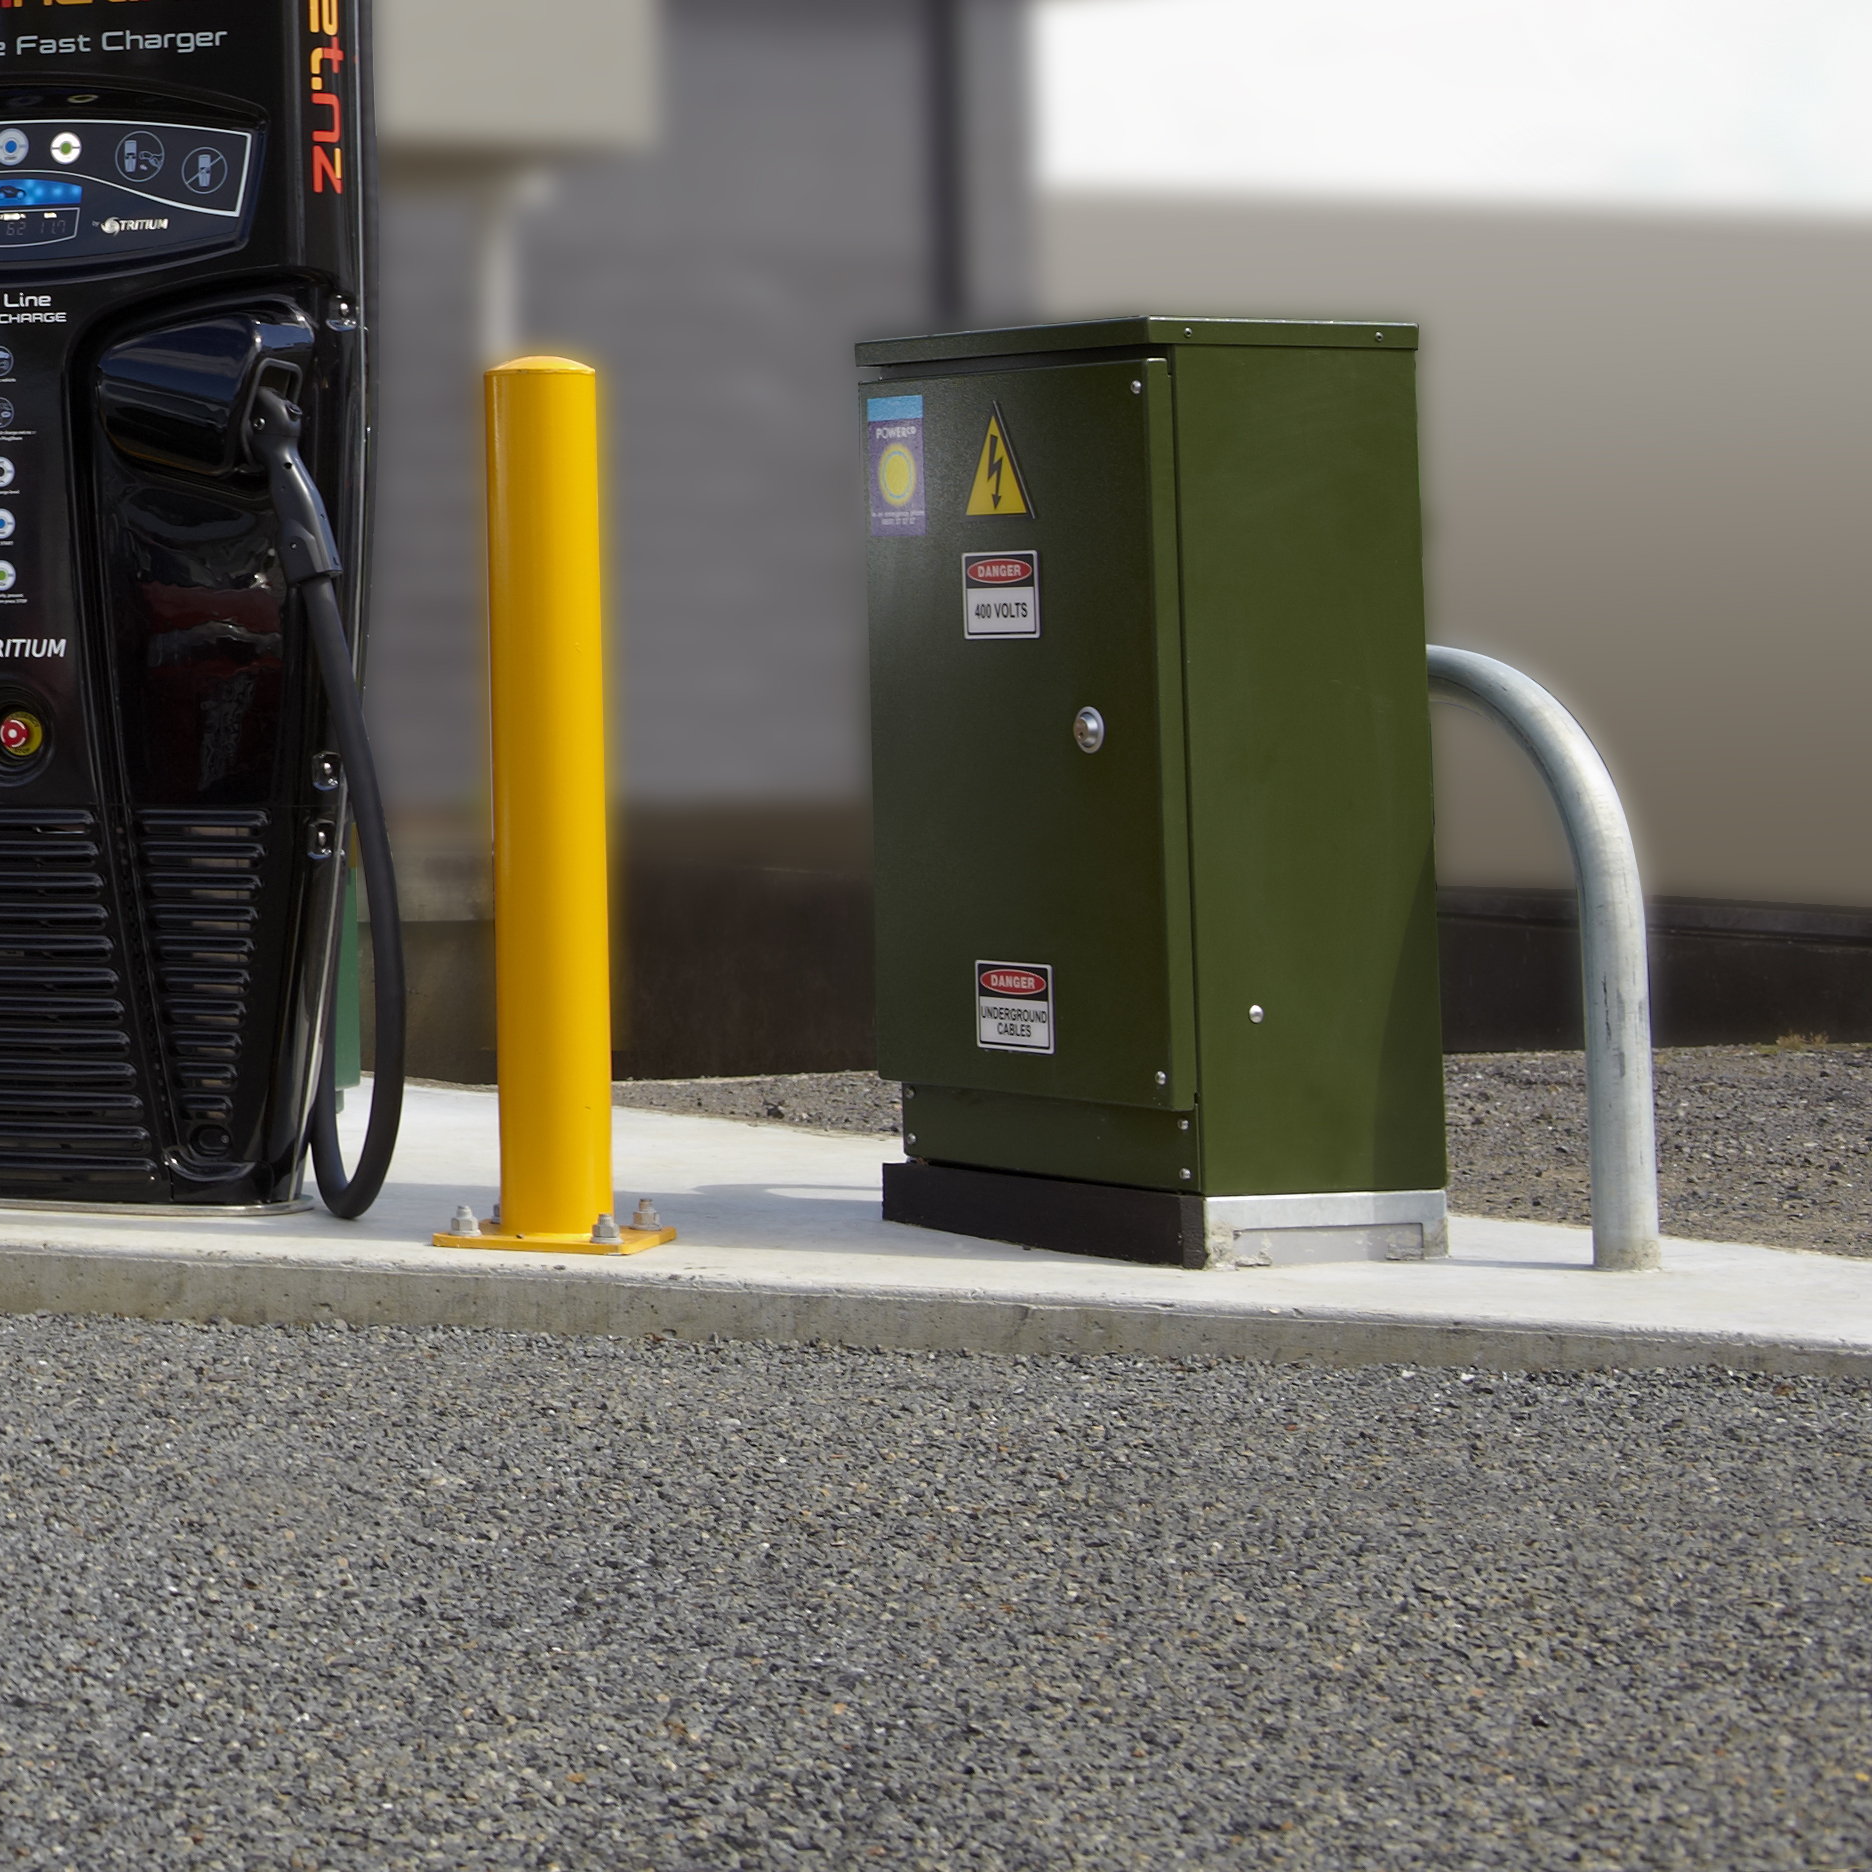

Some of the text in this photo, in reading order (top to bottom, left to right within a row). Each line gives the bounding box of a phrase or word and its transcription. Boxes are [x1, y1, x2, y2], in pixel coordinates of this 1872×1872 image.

[15, 32, 91, 56] Fast
[101, 29, 228, 53] Charger
[119, 218, 169, 231] TRITIUM
[4, 292, 52, 308] Line
[876, 426, 916, 439] POWERCO
[977, 564, 1021, 577] DANGER
[974, 602, 1028, 619] 400 VOLTS
[990, 974, 1036, 989] DANGER
[981, 1006, 1048, 1023] UNDERGROUND
[997, 1022, 1032, 1037] CABLES
